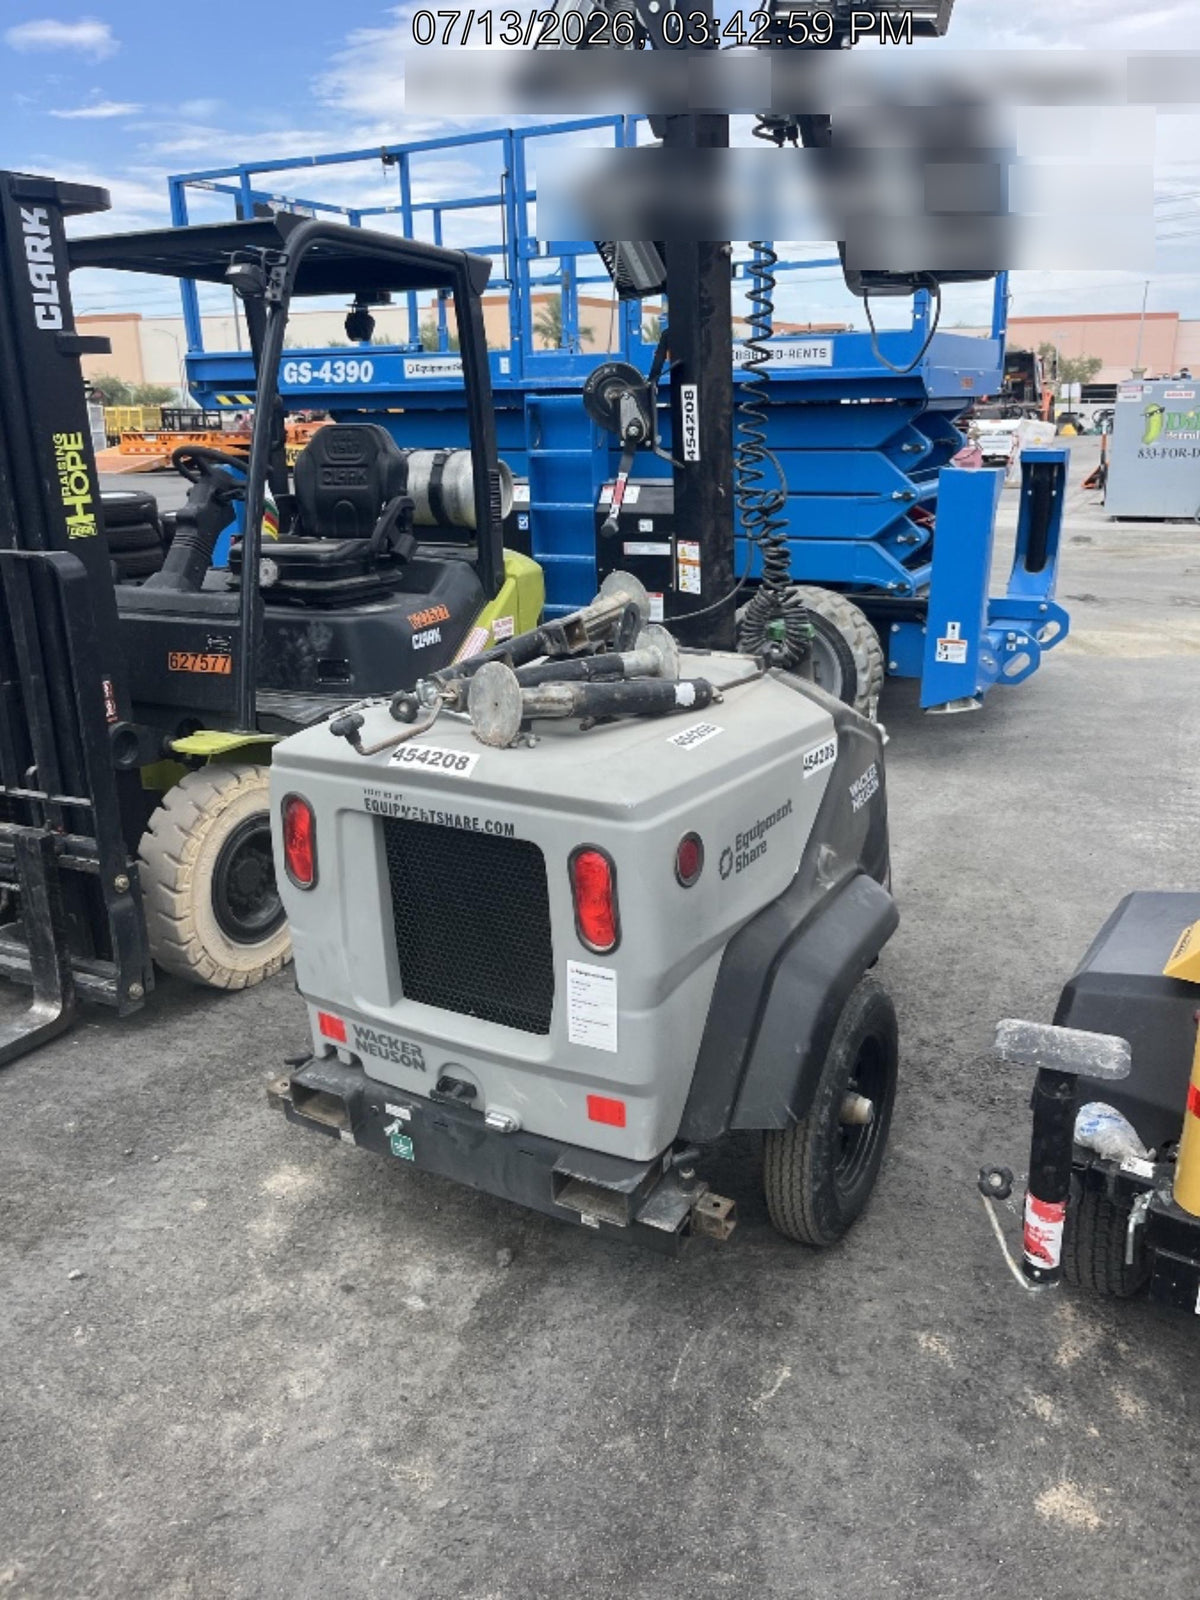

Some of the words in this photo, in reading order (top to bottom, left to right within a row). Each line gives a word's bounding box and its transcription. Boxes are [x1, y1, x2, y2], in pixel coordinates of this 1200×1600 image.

[21, 206, 63, 330] CLARK
[283, 360, 374, 384] GS-4390
[683, 389, 698, 461] 454208
[53, 433, 72, 497] RAISING
[62, 431, 94, 525] HOPE
[412, 627, 442, 650] CLARK
[169, 653, 230, 673] 627577
[392, 747, 470, 771] 454208
[735, 798, 793, 850] Equipment
[735, 840, 768, 874] Share
[352, 1023, 424, 1059] WACKER
[355, 1037, 427, 1073] NEUSON
